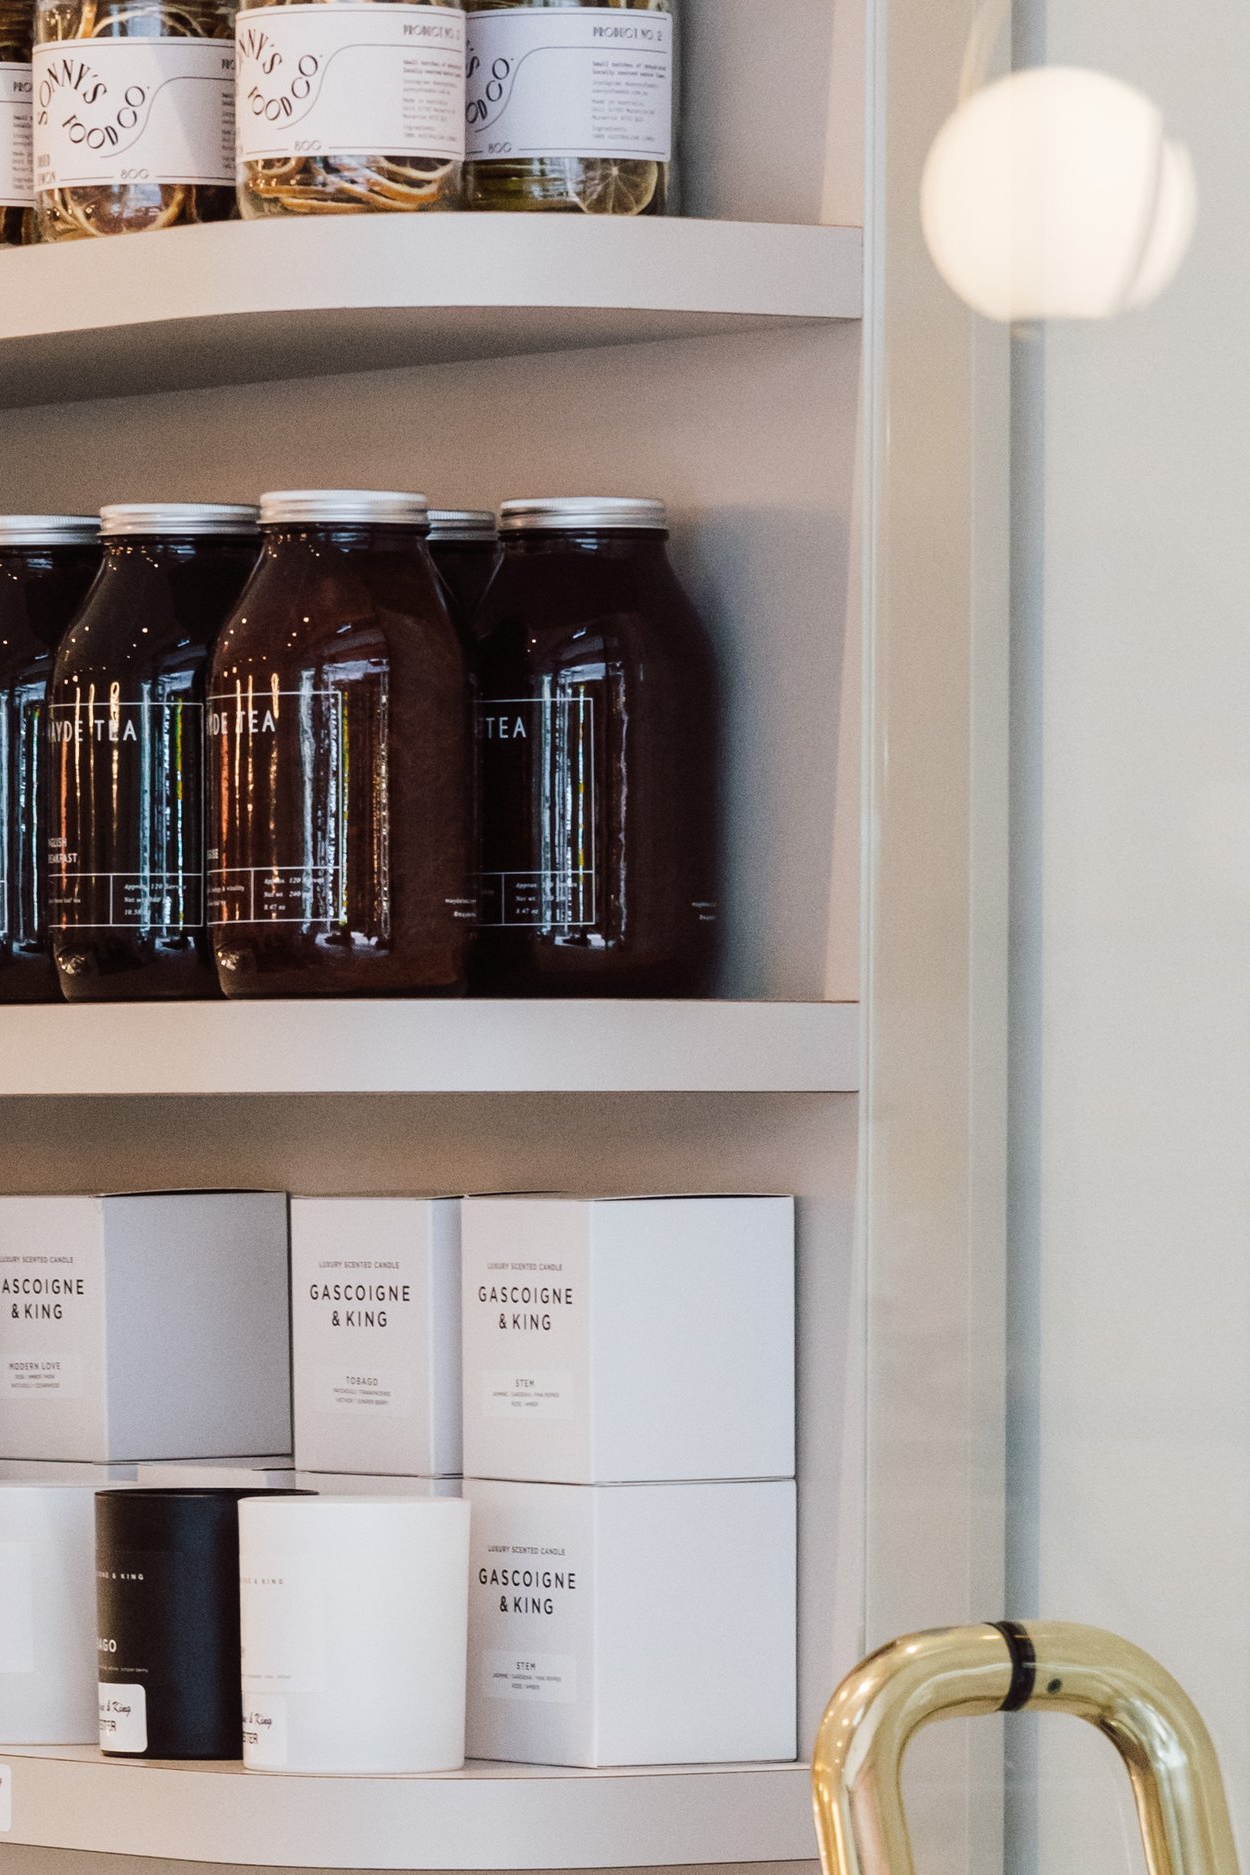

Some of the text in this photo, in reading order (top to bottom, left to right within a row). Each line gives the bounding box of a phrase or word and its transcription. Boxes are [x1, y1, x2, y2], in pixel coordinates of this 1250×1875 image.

[36, 58, 108, 126] SONNY'S
[247, 86, 293, 121] FOOD
[61, 114, 119, 150] FOOD
[235, 710, 276, 733] TEA
[486, 716, 527, 738] TEA
[94, 719, 138, 743] TEA
[50, 1256, 74, 1264] CANDLE
[374, 1262, 400, 1270] CANDLE
[539, 1264, 563, 1272] CANDLE
[310, 1284, 412, 1302] GASCOIGNE
[478, 1286, 573, 1305] GASCOIGNE
[11, 1303, 63, 1319] & KING
[331, 1310, 388, 1327] & KING
[499, 1313, 551, 1331] & KING
[9, 1362, 62, 1371] MODERN LOVE
[346, 1376, 379, 1386] TOBAGO
[515, 1379, 535, 1388] STEM
[540, 1548, 566, 1556] CANDLE
[120, 1573, 144, 1581] KING
[479, 1568, 577, 1590] GASCOIGNE
[499, 1595, 554, 1615] & KING
[516, 1661, 536, 1671] STEM
[112, 1701, 131, 1718] King
[254, 1713, 272, 1729] King
